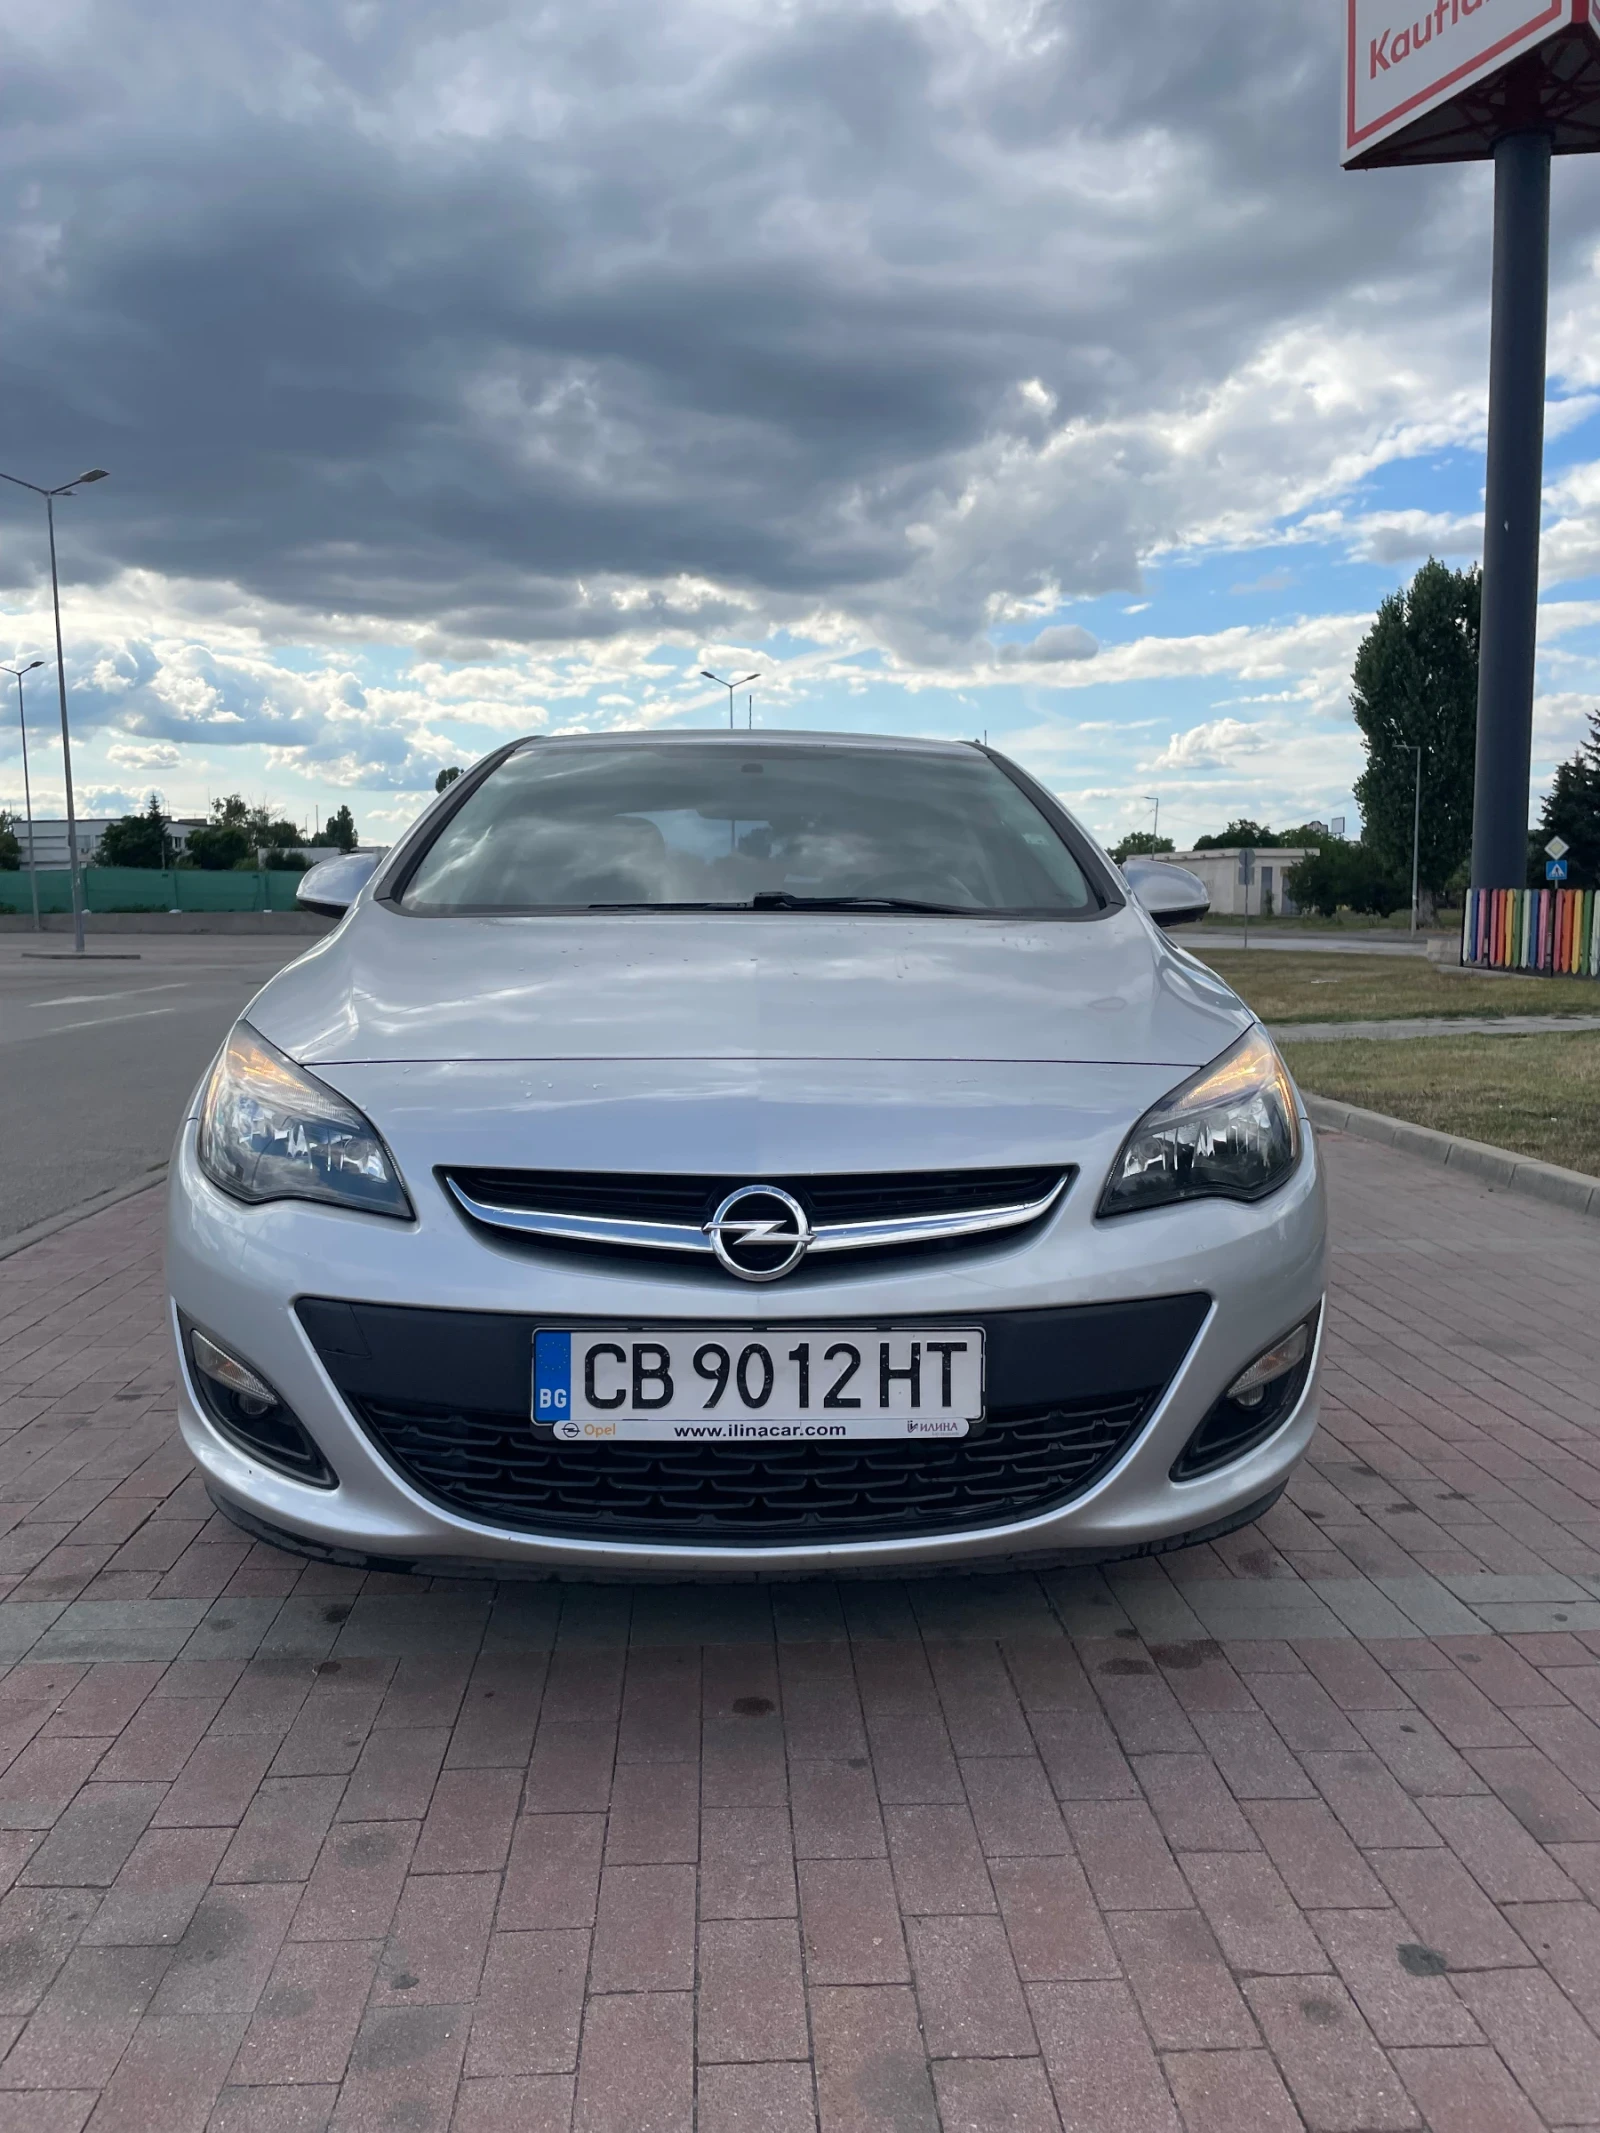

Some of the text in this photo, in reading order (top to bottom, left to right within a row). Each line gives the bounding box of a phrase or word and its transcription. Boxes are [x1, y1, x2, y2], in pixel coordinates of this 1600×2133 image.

[1370, 0, 1490, 80] Kaufla
[584, 1342, 968, 1409] CB 9012 HT
[539, 1388, 567, 1408] BG
[584, 1423, 616, 1437] Opel
[674, 1424, 846, 1438] www.ilinacar.com
[920, 1422, 958, 1432] ИЛИНА
